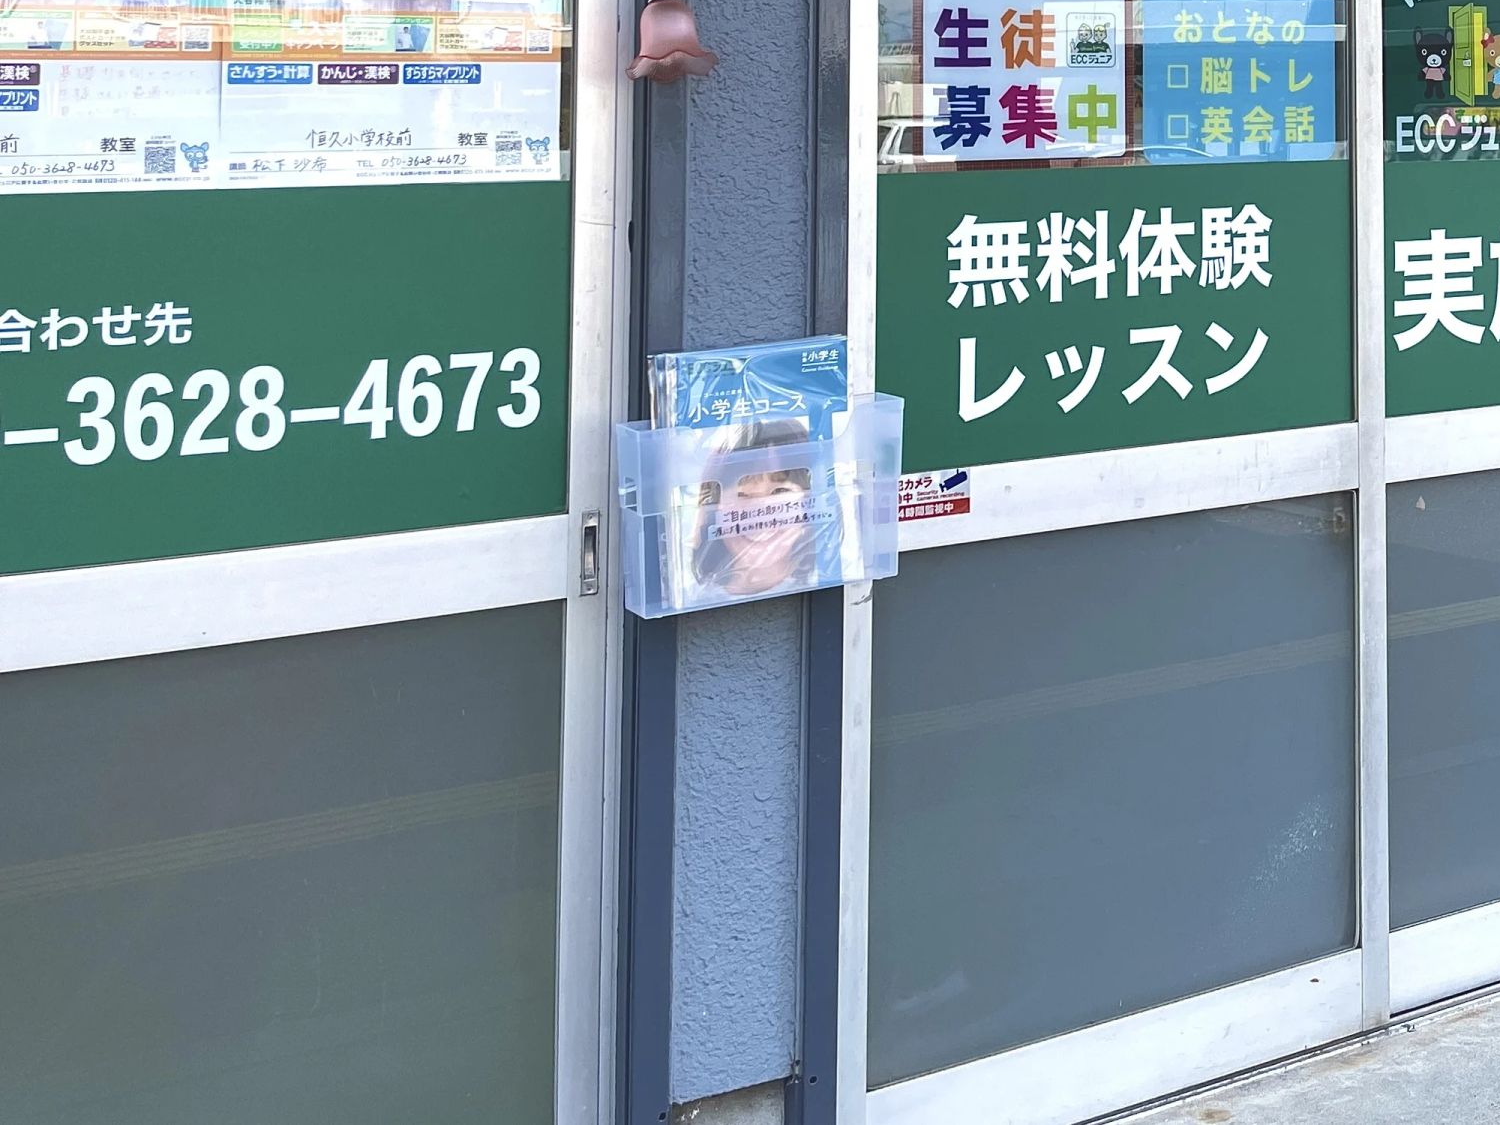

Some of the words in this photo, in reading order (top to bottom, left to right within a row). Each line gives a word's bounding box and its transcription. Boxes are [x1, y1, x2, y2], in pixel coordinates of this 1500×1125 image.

[934, 7, 1056, 70] 生徒
[1173, 8, 1306, 46] おとなの
[230, 65, 310, 80] さんすう・計算
[405, 65, 480, 80] すらすらマイプリント
[1200, 57, 1313, 95] 脳トレ
[933, 83, 1118, 151] 募集中
[1200, 105, 1315, 144] 英会話
[100, 136, 137, 153] 教室
[458, 132, 488, 146] 教室
[356, 159, 374, 168] TEL
[946, 203, 1274, 310] 無料体験
[957, 321, 1270, 423] レッスン
[688, 395, 807, 423] 小学生コース
